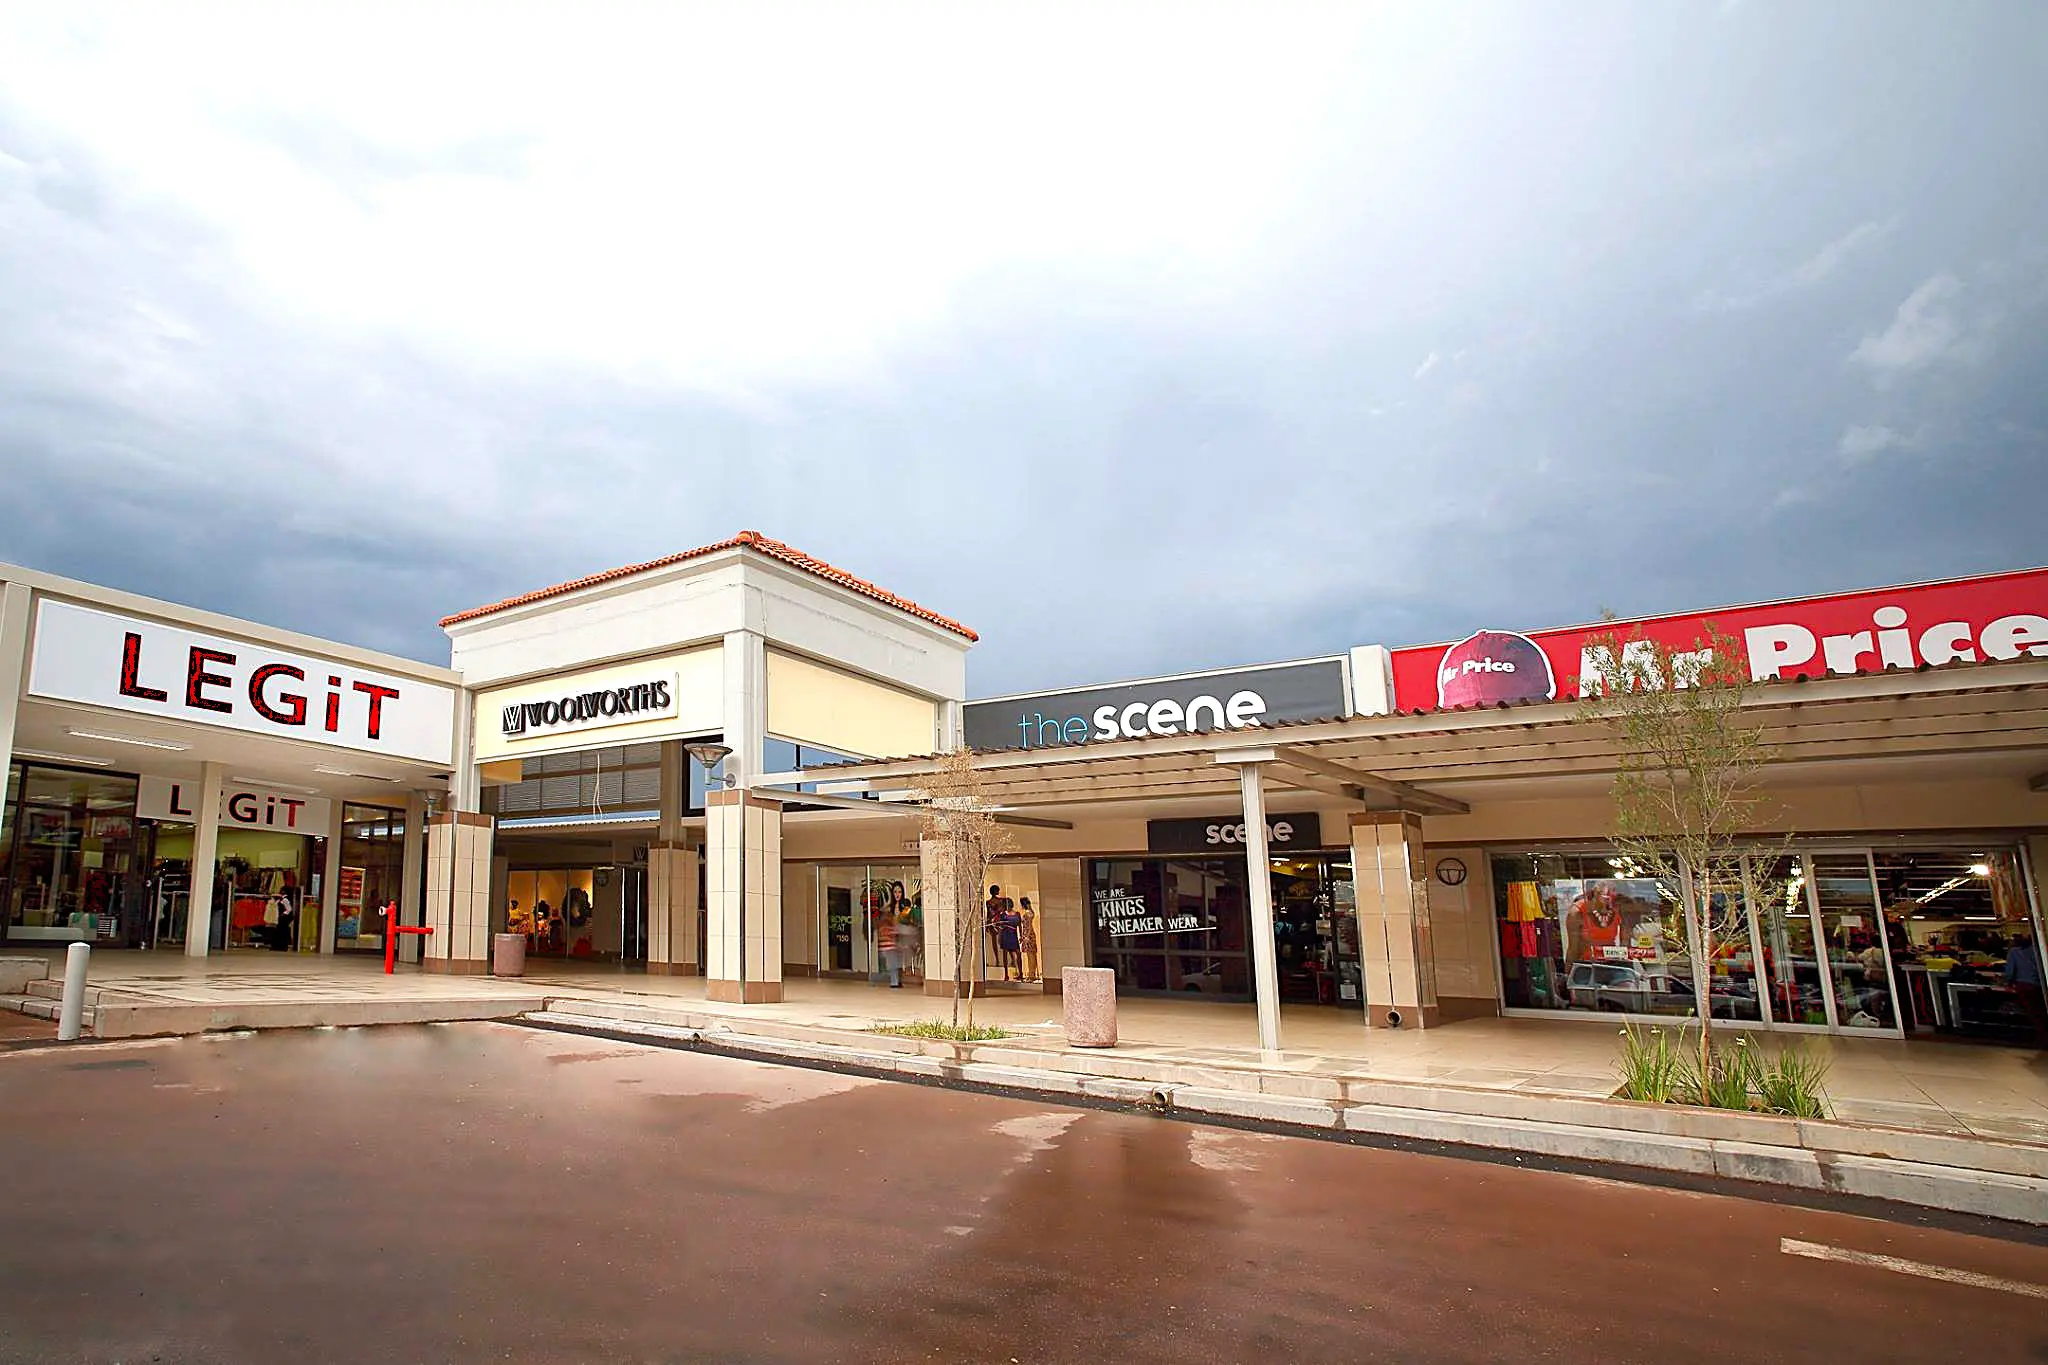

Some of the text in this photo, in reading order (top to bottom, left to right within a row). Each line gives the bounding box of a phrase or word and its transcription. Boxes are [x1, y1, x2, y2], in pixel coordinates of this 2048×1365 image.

[1462, 656, 1516, 676] Price
[1579, 606, 2048, 698] Mr Price
[526, 680, 671, 727] WOOLWORTHS
[1018, 690, 1267, 748] the scene
[170, 784, 305, 827] LGiT
[1094, 887, 1126, 899] WE ARE
[1101, 899, 1146, 918] KINGS
[1109, 917, 1165, 934] SNEAKER
[1168, 916, 1199, 930] WEAR
